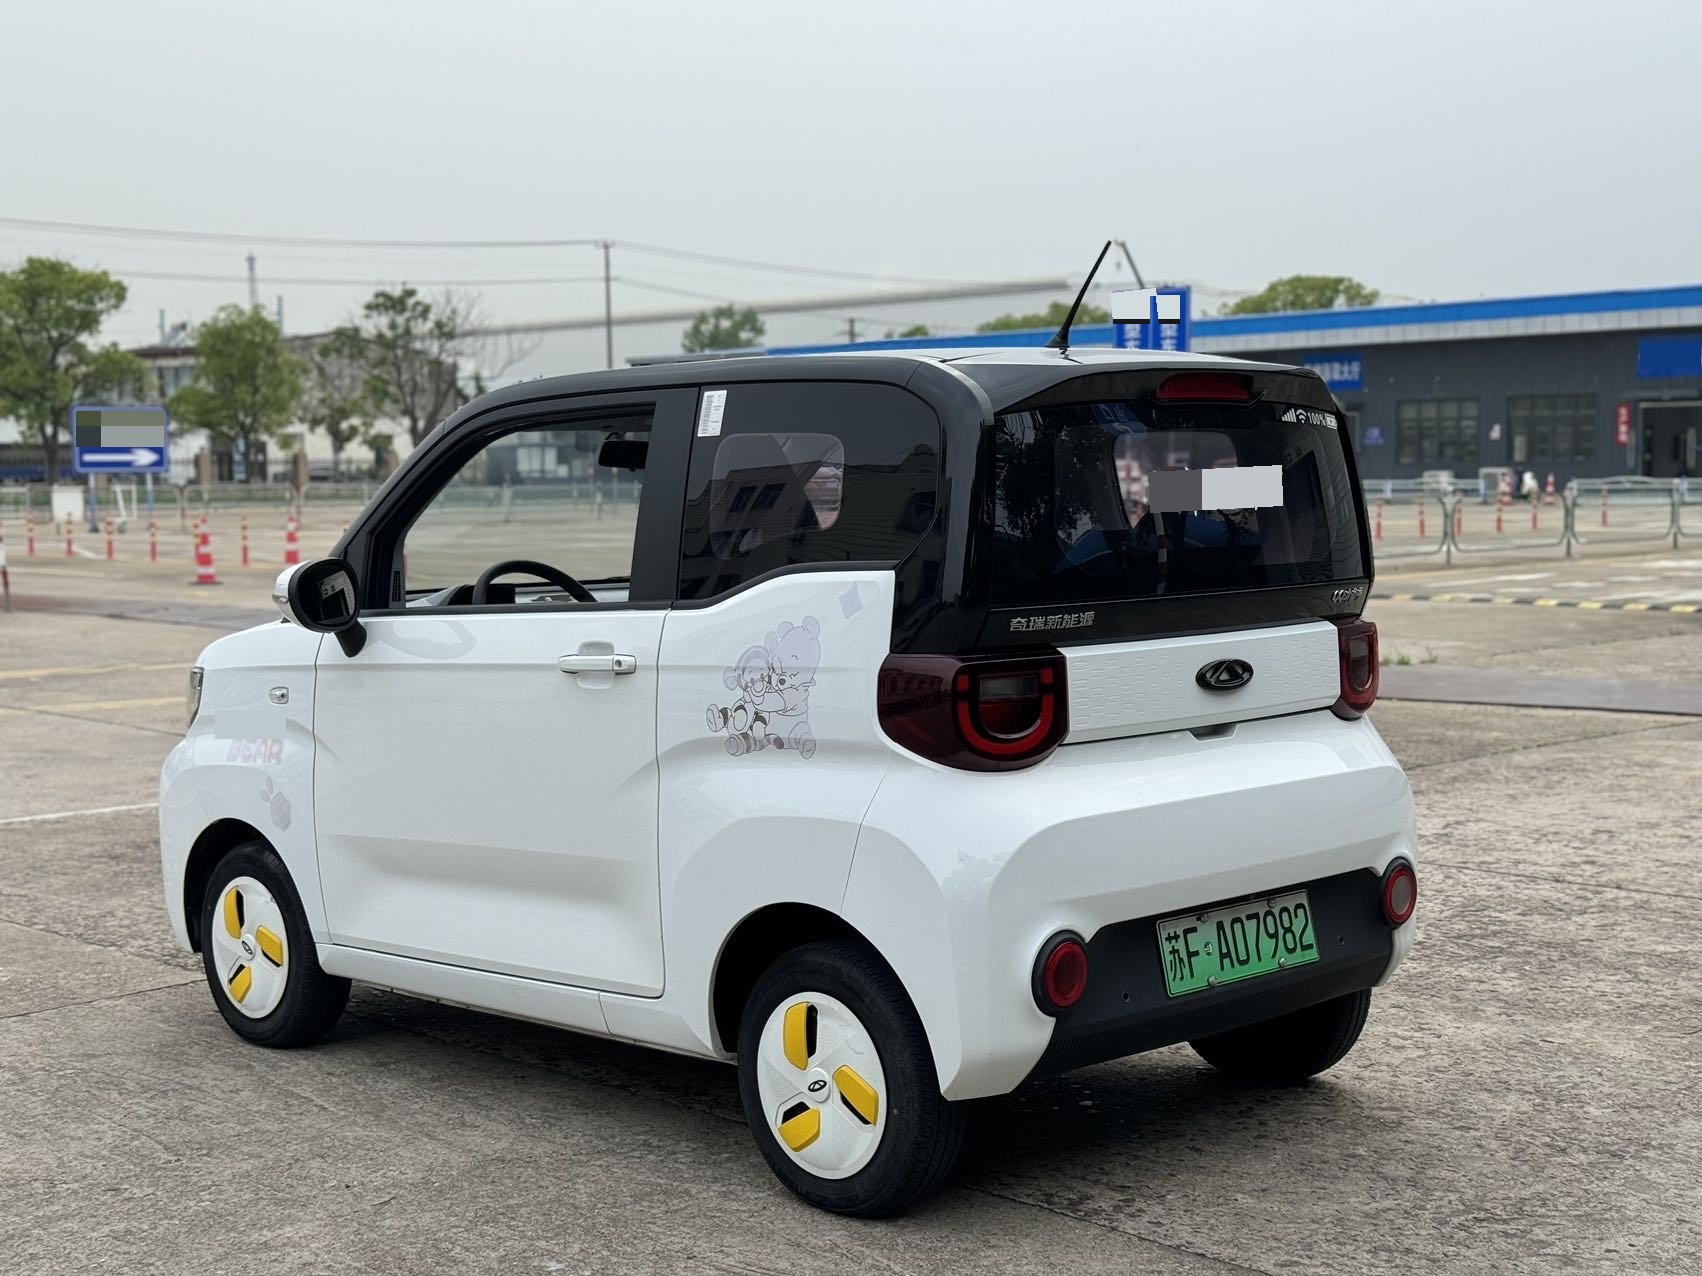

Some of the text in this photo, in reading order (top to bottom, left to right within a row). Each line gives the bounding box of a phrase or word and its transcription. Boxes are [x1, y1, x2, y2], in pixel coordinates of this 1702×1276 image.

[1307, 412, 1326, 426] 100%
[1010, 611, 1095, 631] 奇瑞新能源
[226, 738, 285, 766] BEAR
